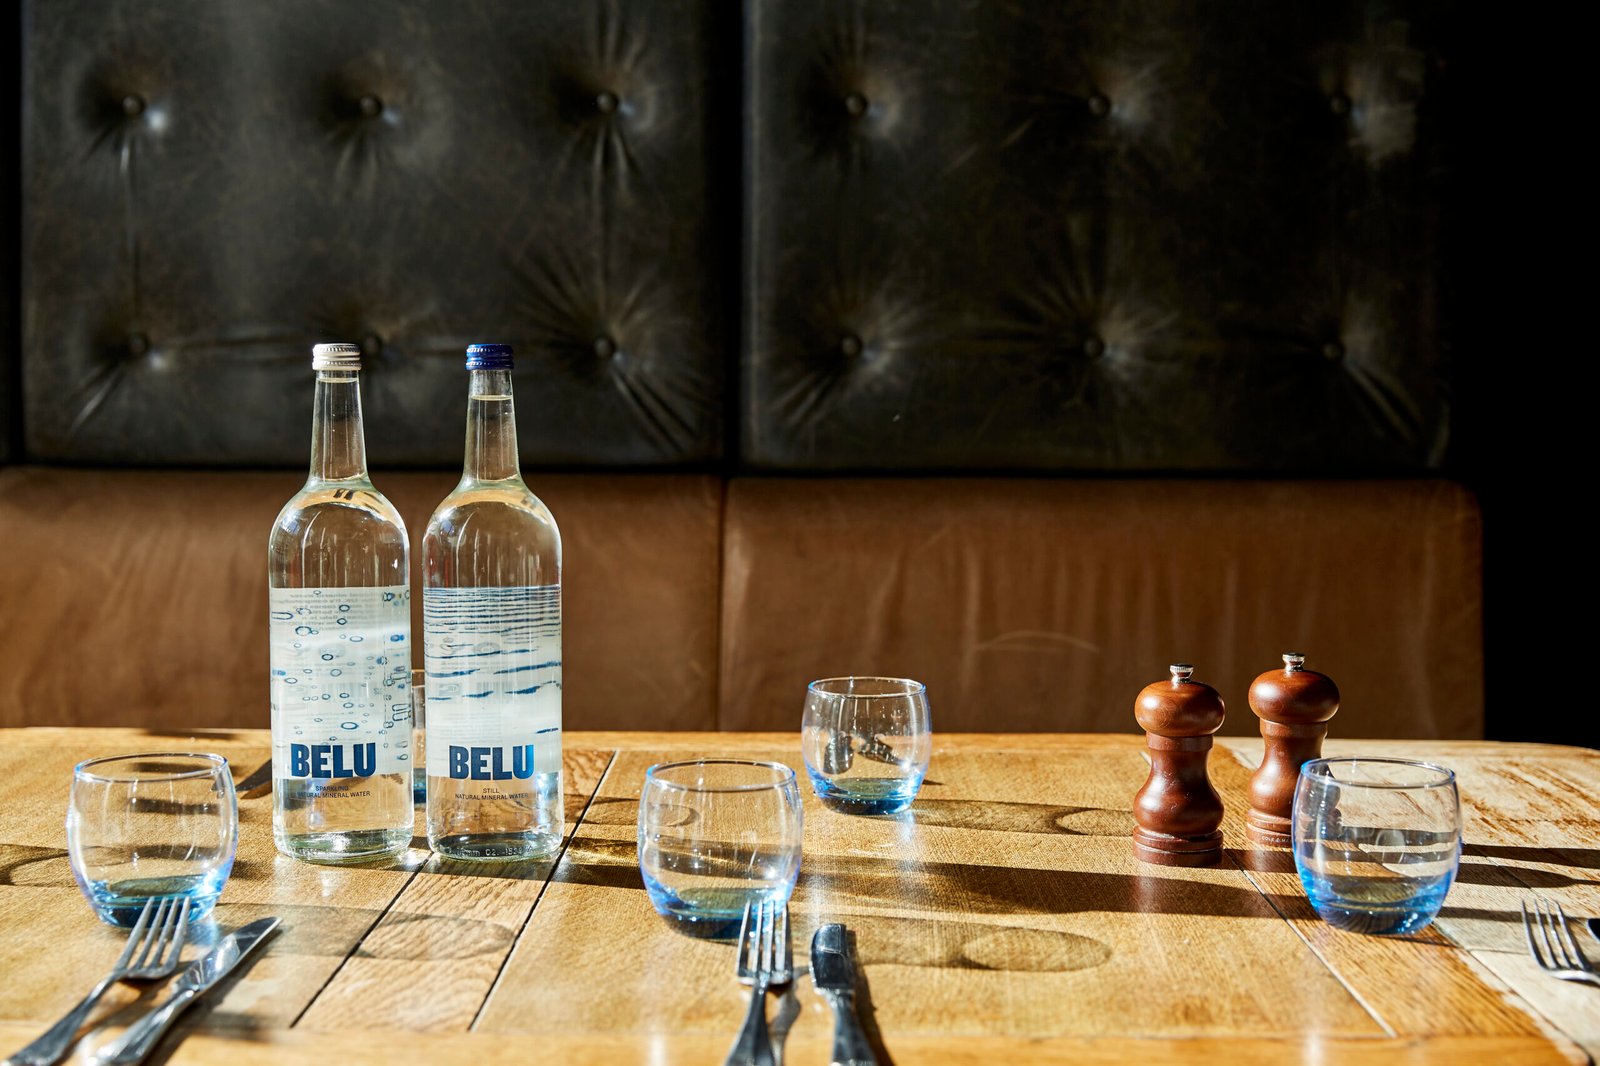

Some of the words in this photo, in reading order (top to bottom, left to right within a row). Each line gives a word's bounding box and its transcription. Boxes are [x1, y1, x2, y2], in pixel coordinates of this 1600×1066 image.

[290, 742, 376, 778] BELU
[449, 744, 534, 780] BELU
[322, 791, 349, 799] MINERAL
[350, 790, 371, 798] WATER
[455, 793, 480, 801] NATURAL
[481, 793, 508, 801] MINERAL
